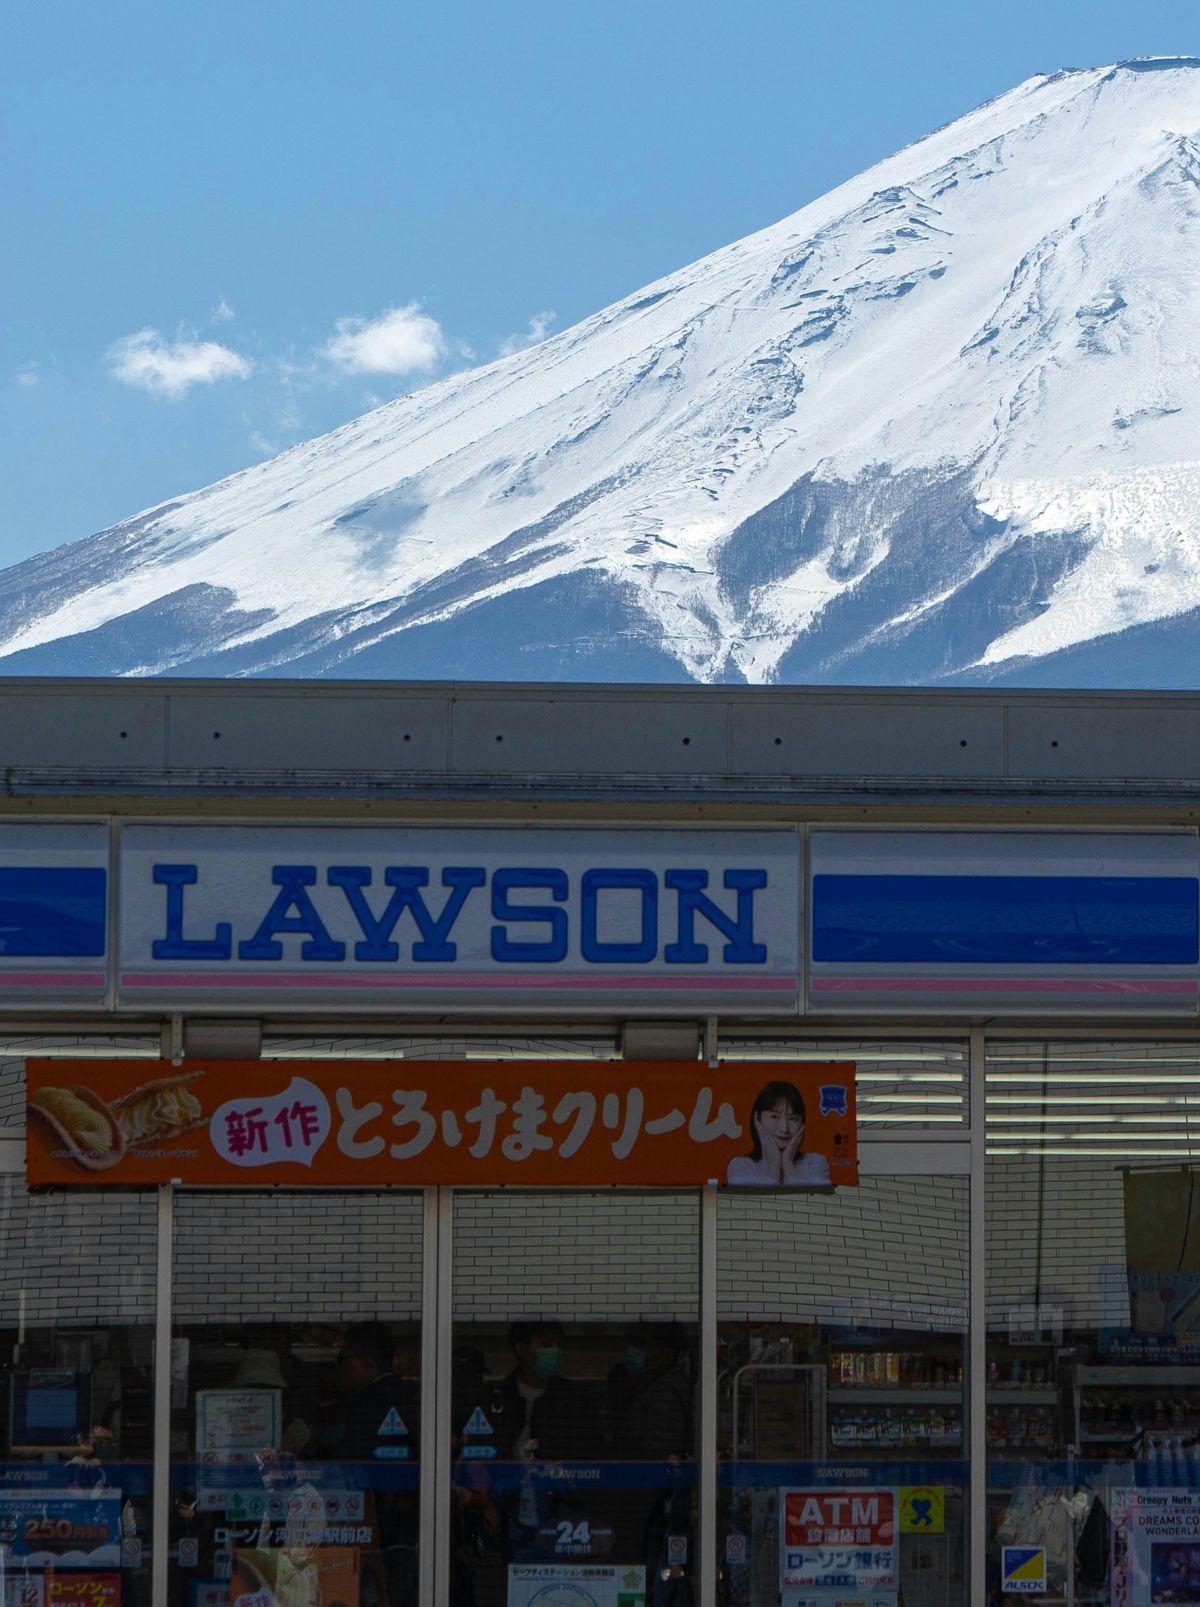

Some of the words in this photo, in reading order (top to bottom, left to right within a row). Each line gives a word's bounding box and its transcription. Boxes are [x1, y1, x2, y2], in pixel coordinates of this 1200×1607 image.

[152, 864, 768, 963] LAWSON
[224, 1101, 321, 1157] 新作
[335, 1086, 742, 1161] とろけまクリーム
[551, 1469, 601, 1480] LAWSON
[816, 1468, 869, 1479] LAWSON
[1137, 1495, 1168, 1506] Creepy
[1171, 1495, 1192, 1505] Nuts
[799, 1497, 879, 1526] ATM
[1138, 1516, 1183, 1526] DREAMS
[556, 1520, 590, 1545] 24
[807, 1528, 871, 1544] 設置店舗
[787, 1552, 893, 1570] ローソン銀行
[1004, 1581, 1044, 1590] ALSOK
